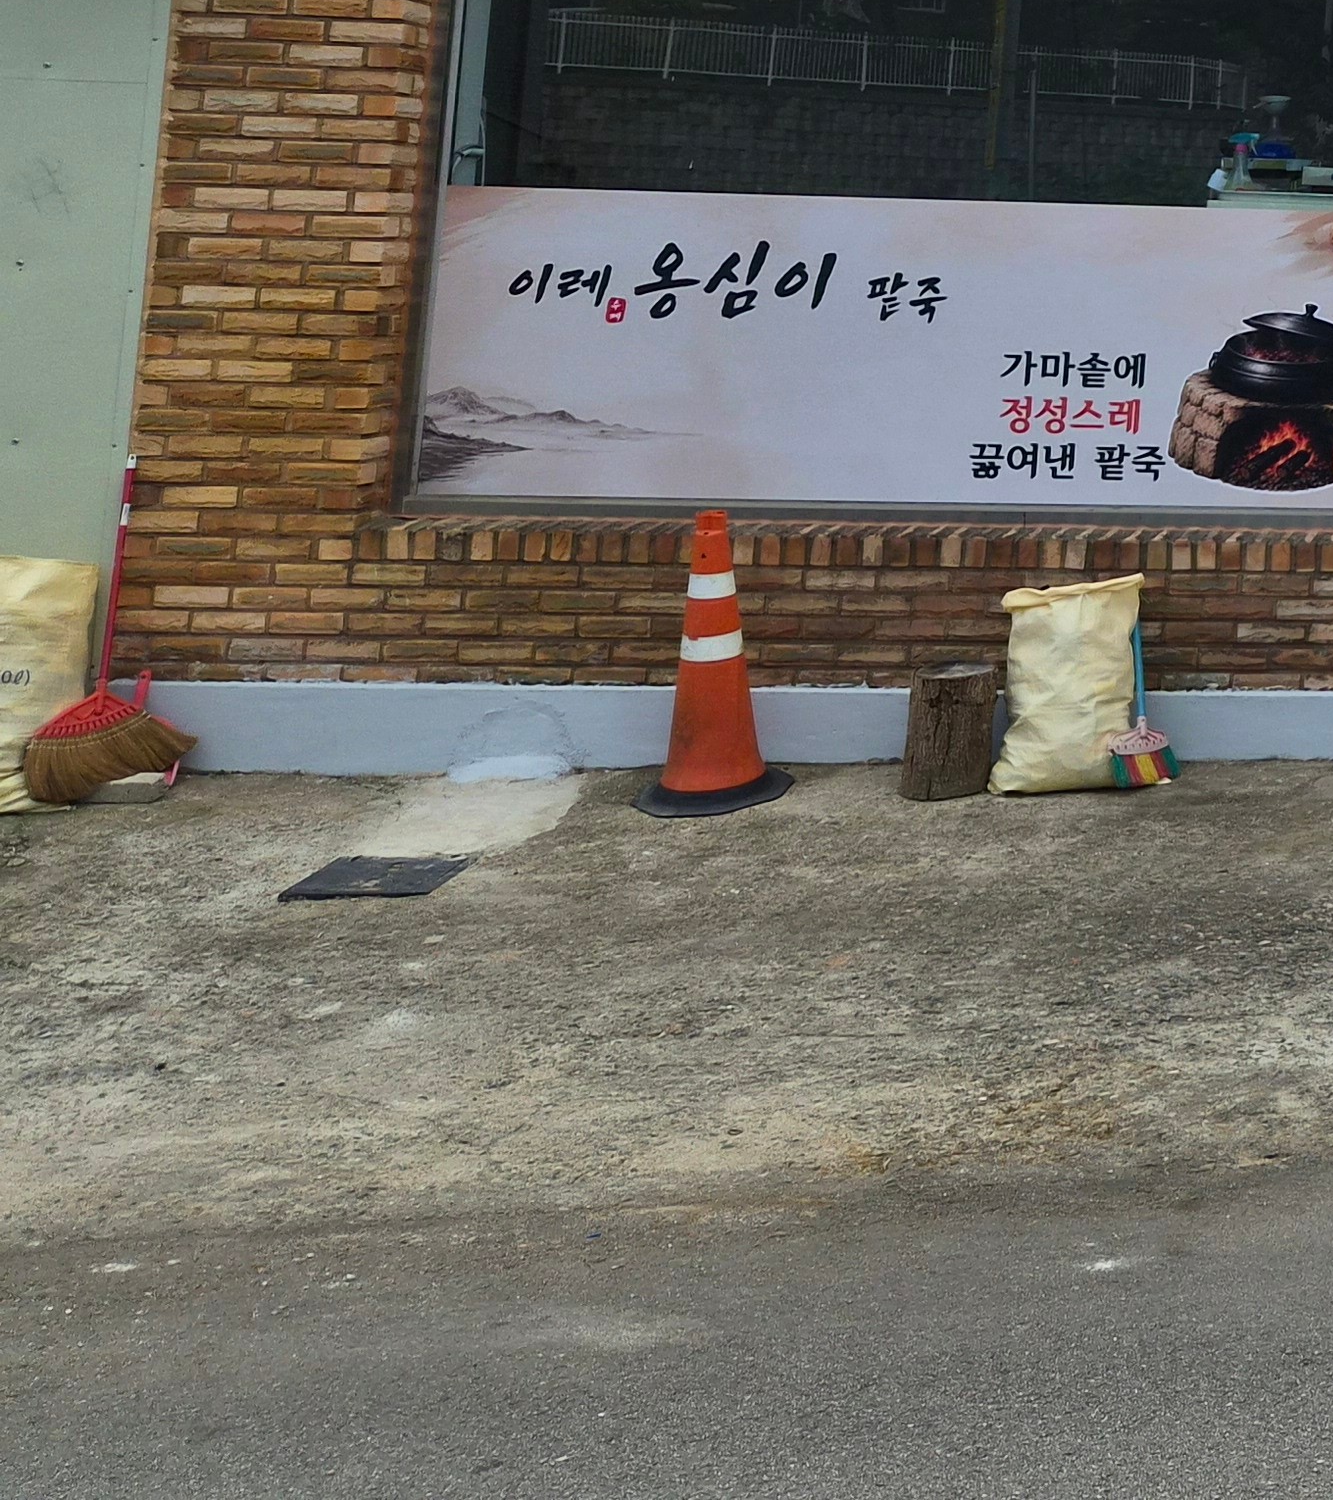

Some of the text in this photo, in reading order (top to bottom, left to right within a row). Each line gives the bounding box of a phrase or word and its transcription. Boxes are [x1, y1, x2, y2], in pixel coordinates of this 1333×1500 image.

[508, 241, 948, 324] 이레 옹심이 팥죽
[1000, 351, 1147, 389] 가마솥에
[1000, 396, 1141, 435] 정성스레
[969, 443, 1166, 482] 끓여낸 팥죽
